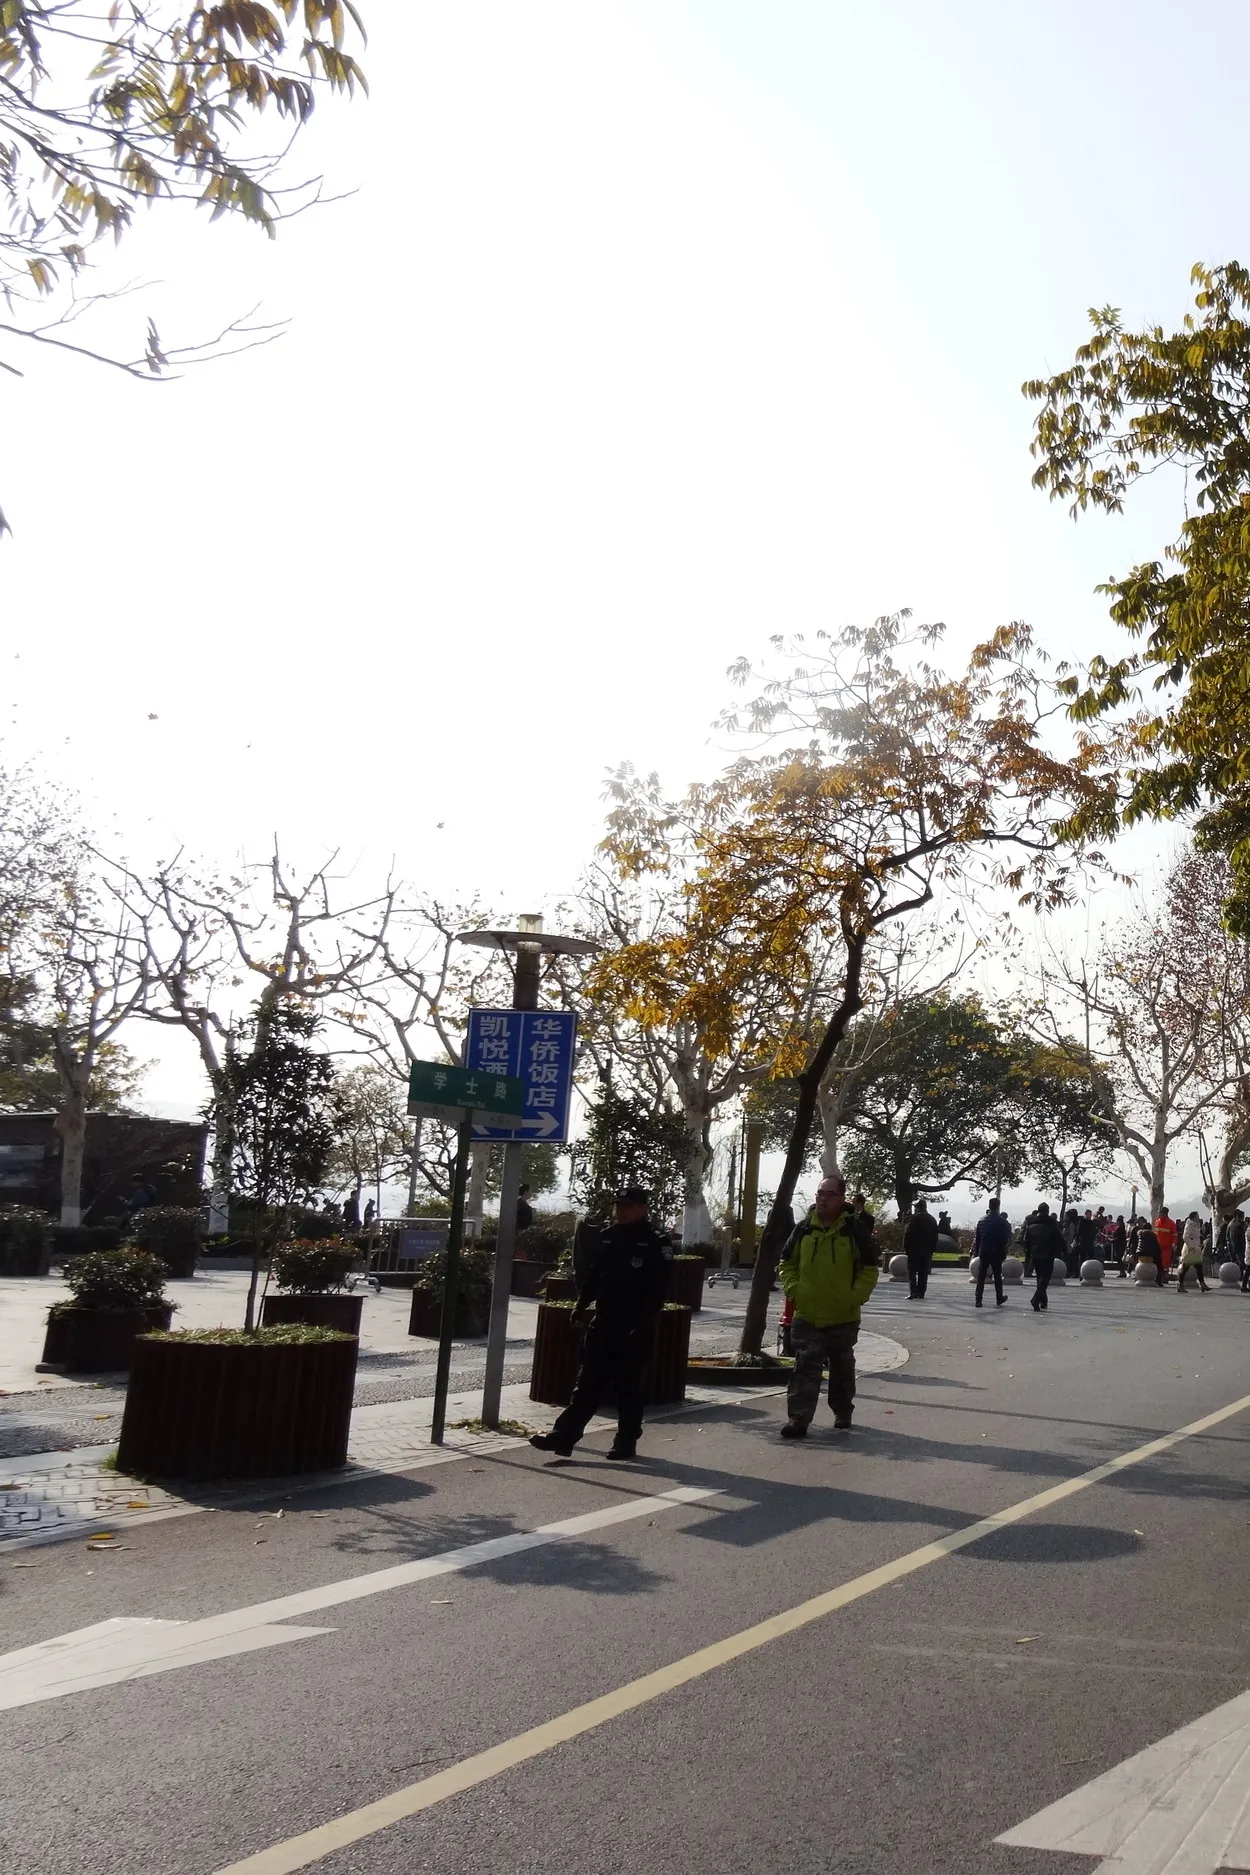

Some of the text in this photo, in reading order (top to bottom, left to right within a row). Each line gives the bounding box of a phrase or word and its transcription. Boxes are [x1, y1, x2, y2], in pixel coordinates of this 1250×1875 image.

[433, 1071, 508, 1099] 学士路
[526, 1018, 562, 1107] 华侨饭店
